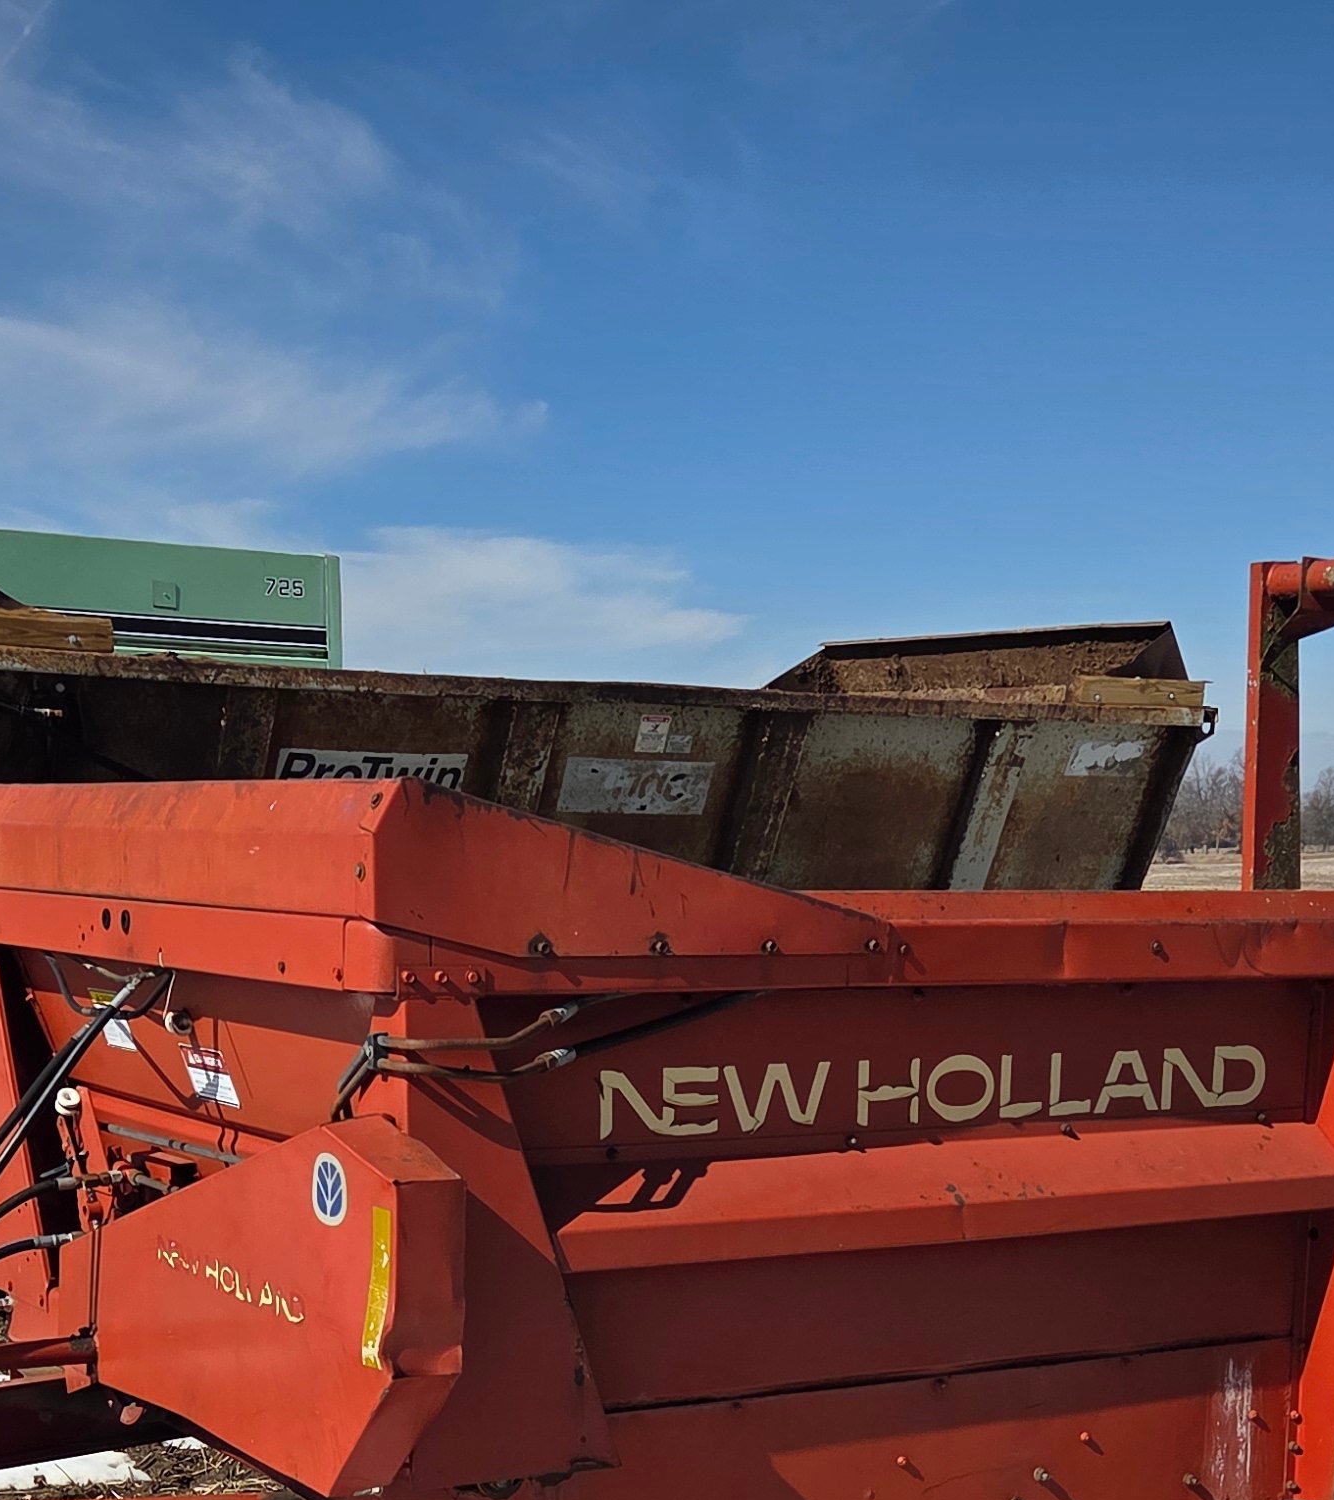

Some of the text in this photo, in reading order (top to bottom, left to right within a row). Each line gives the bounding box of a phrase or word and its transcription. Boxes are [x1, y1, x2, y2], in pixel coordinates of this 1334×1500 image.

[264, 576, 305, 599] 725
[278, 752, 463, 789] ProTwin
[599, 1045, 1266, 1140] NEW HOLLAND
